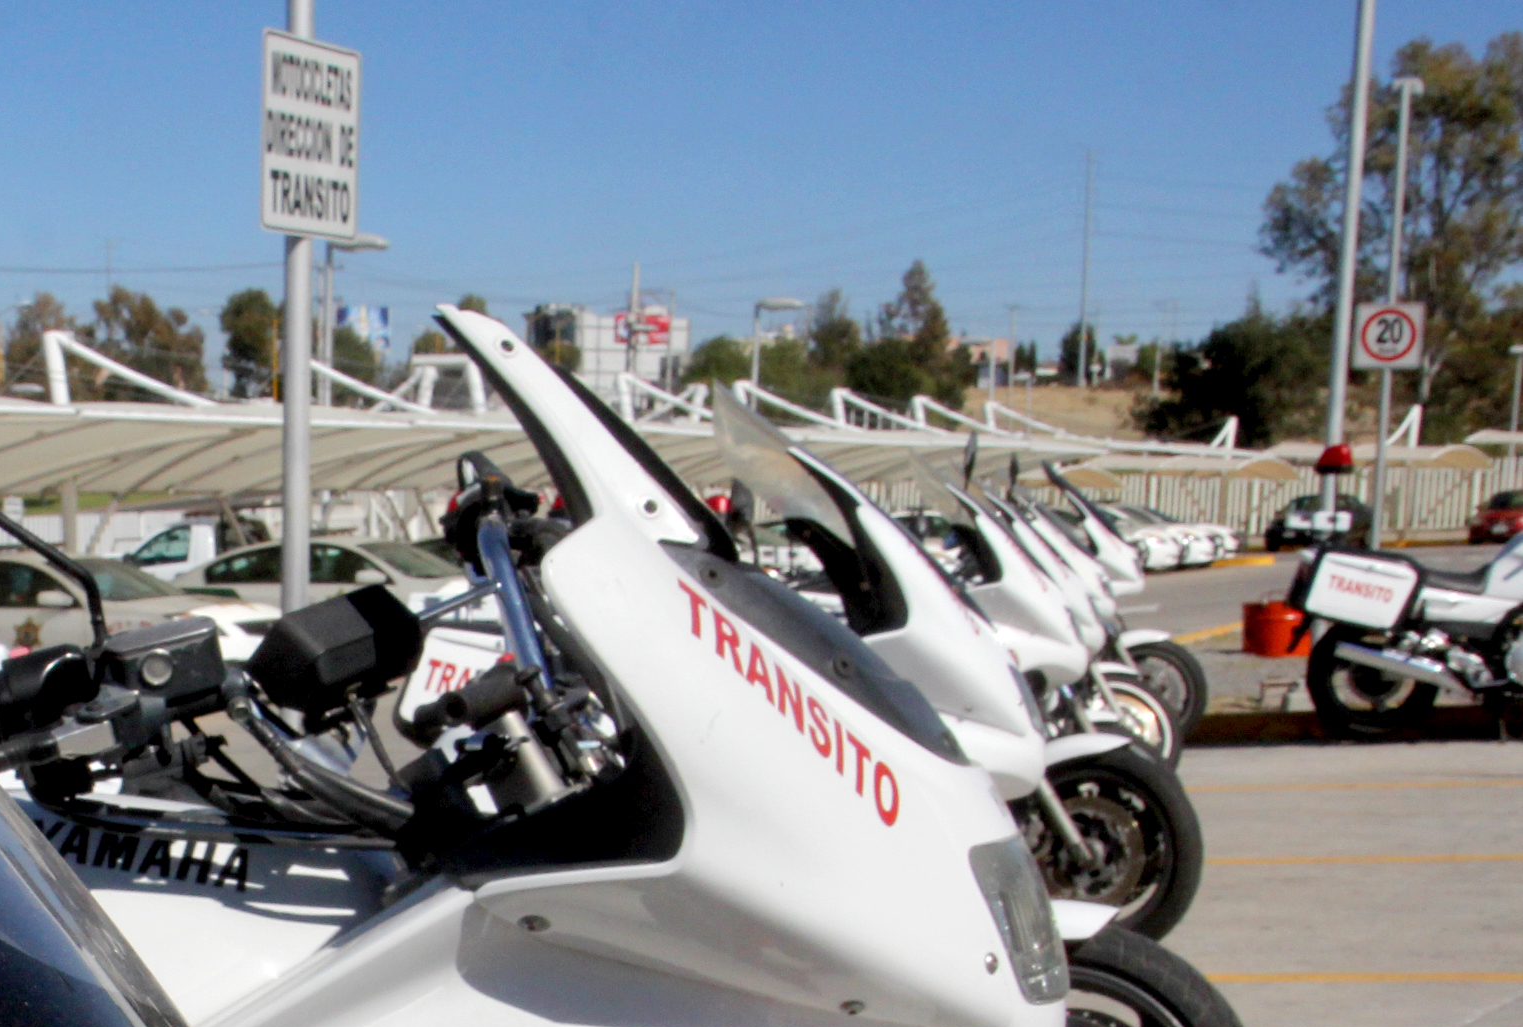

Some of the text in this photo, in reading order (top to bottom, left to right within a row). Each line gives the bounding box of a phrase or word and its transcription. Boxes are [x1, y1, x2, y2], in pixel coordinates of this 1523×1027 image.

[272, 51, 352, 111] MOTOCICLETAS
[267, 110, 353, 168] DIRECCION DE
[271, 168, 350, 223] TRANSITO
[1377, 317, 1403, 344] 20
[1328, 573, 1394, 604] TRANSITO
[677, 578, 900, 827] TRANSITO
